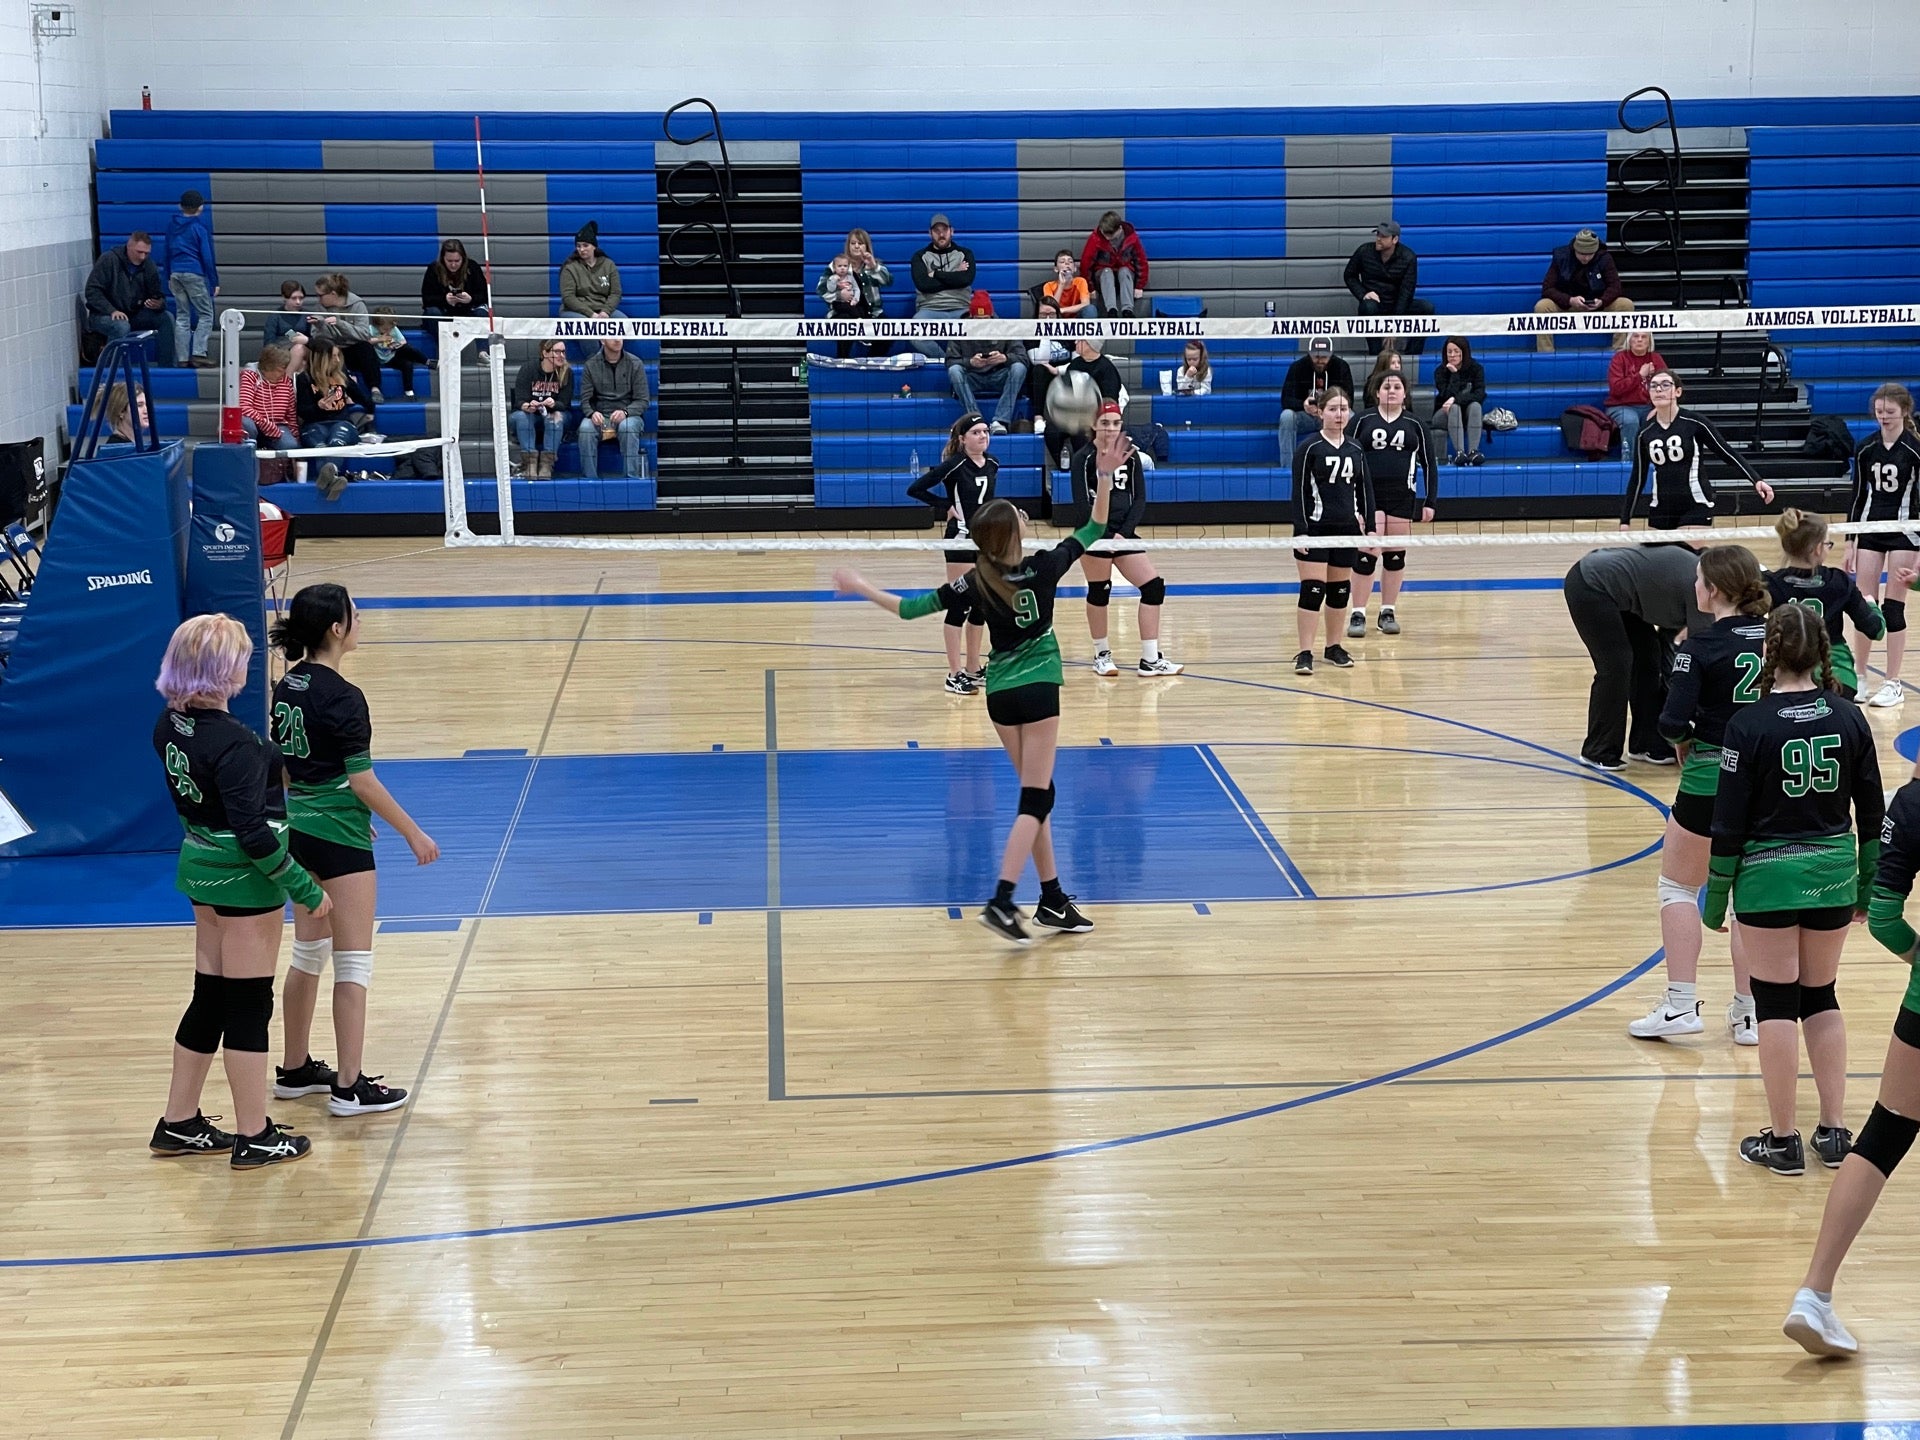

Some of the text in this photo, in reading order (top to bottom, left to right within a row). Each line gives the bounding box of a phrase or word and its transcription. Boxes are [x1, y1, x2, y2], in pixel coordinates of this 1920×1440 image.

[555, 322, 728, 336] ANAMOSA VOLLEYBALL
[797, 322, 967, 336] ANAMOSA VOLLEYBALL
[1035, 321, 1204, 336] ANAMOSA VOLLEYBALL
[1272, 319, 1440, 334] ANAMOSA VOLLEYBALL
[1508, 314, 1678, 331] ANAMOSA VOLLEYBALL
[1746, 309, 1916, 326] ANAMOSA VOLLEYBALL
[1371, 428, 1405, 451] 84
[1649, 435, 1684, 466] 68
[1325, 456, 1353, 484] 74
[1871, 462, 1899, 493] 13
[975, 476, 988, 504] 7
[87, 569, 153, 591] SPALDING
[1012, 589, 1040, 628] 9
[1733, 653, 1767, 702] 2
[275, 702, 311, 759] 28
[1782, 734, 1841, 798] 95
